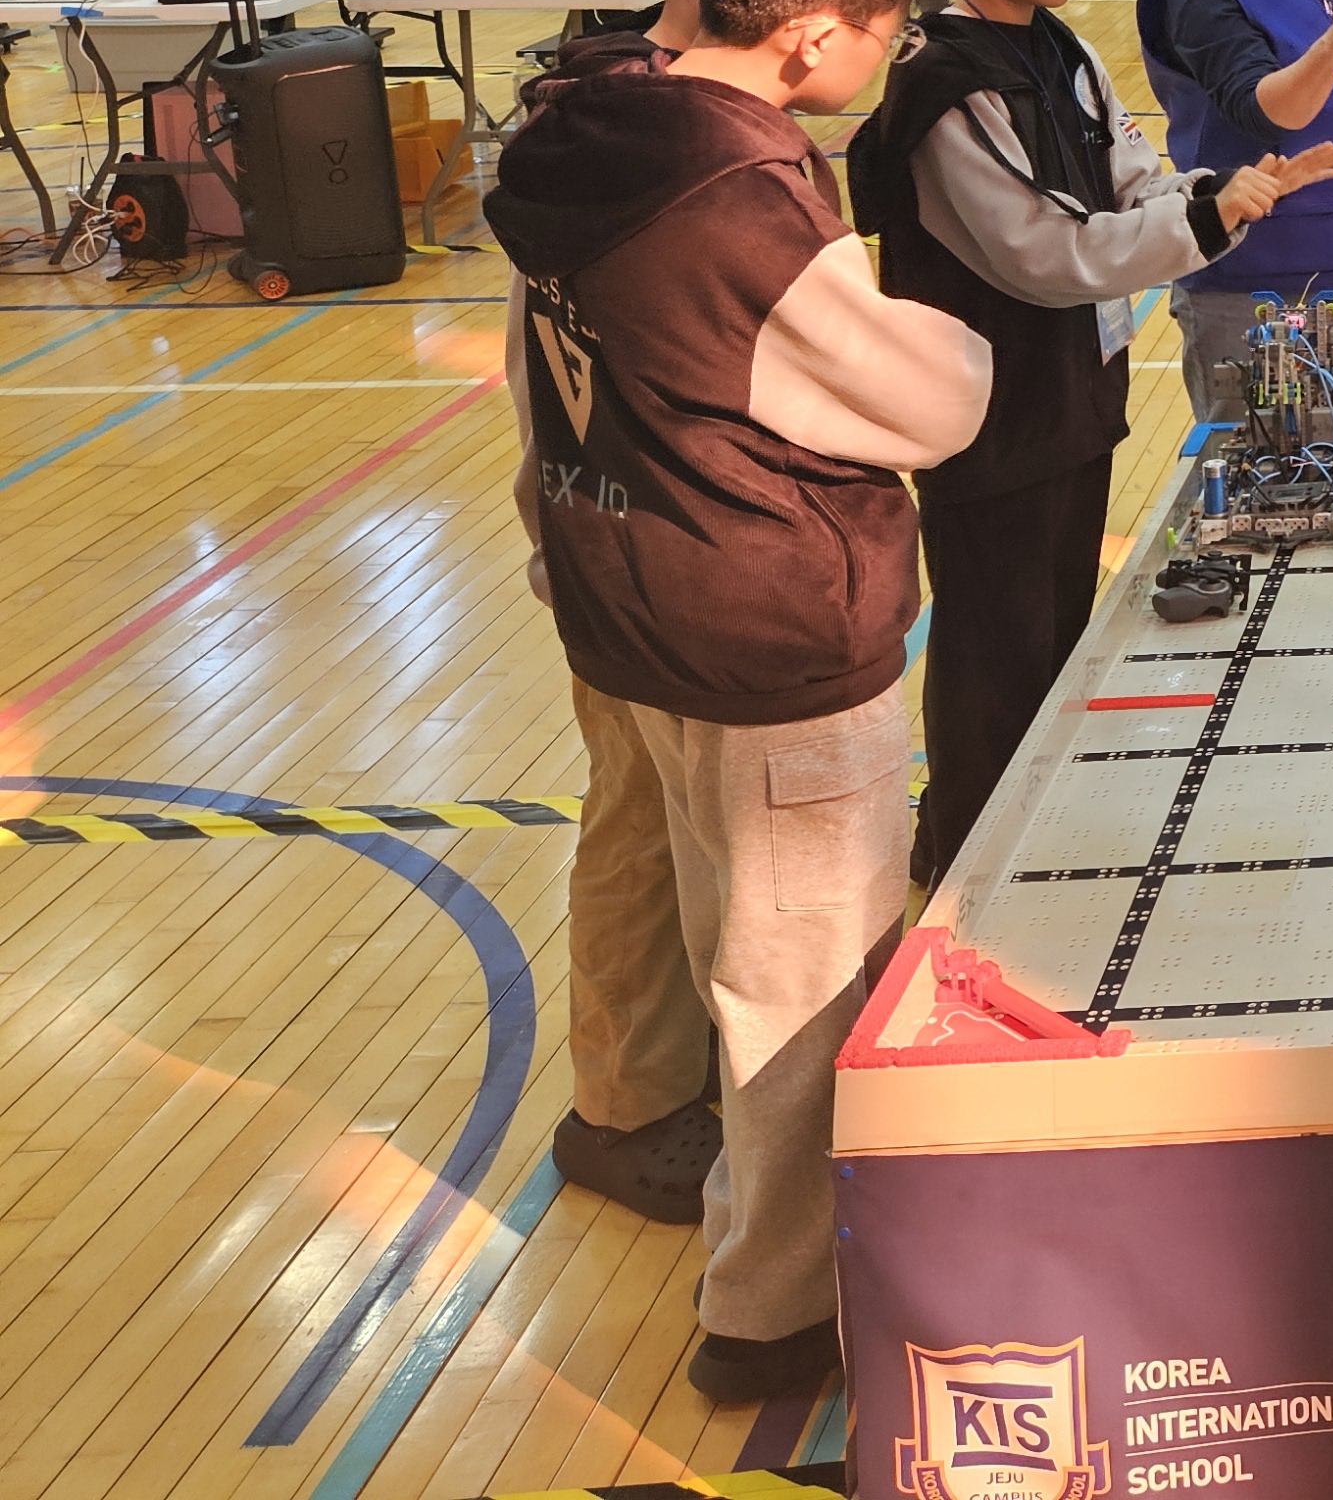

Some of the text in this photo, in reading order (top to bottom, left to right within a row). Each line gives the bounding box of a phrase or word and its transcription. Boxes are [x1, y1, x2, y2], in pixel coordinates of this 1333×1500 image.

[537, 458, 582, 509] EX
[1124, 1357, 1232, 1394] KOREA
[951, 1395, 1054, 1454] KIS
[986, 1472, 1024, 1485] JEJU
[1127, 1454, 1254, 1495] SCHOOL
